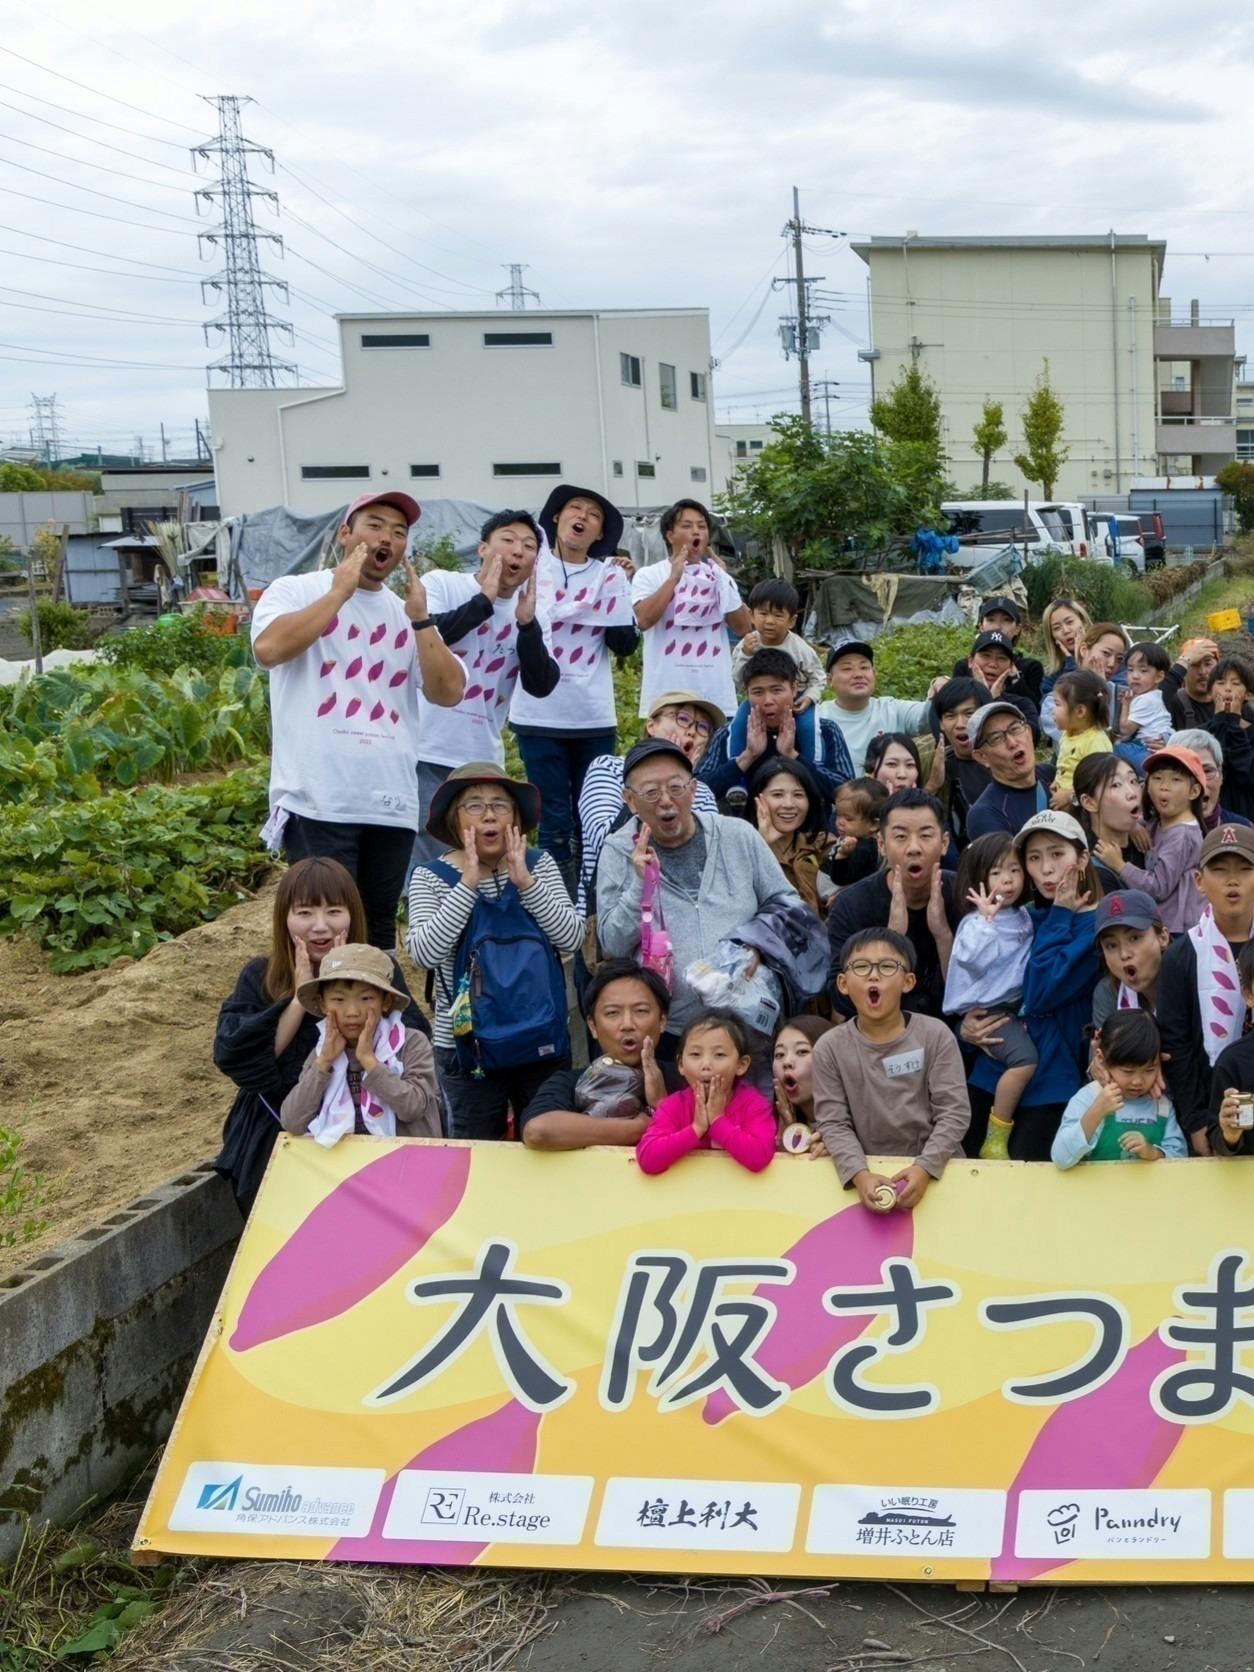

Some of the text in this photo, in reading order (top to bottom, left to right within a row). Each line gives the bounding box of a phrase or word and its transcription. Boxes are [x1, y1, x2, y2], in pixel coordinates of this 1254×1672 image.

[488, 1492, 536, 1505] 株式会社
[880, 1496, 940, 1509] いい眠り工房
[463, 1505, 551, 1531] Re.stage
[856, 1527, 956, 1546] 増井ふとん店
